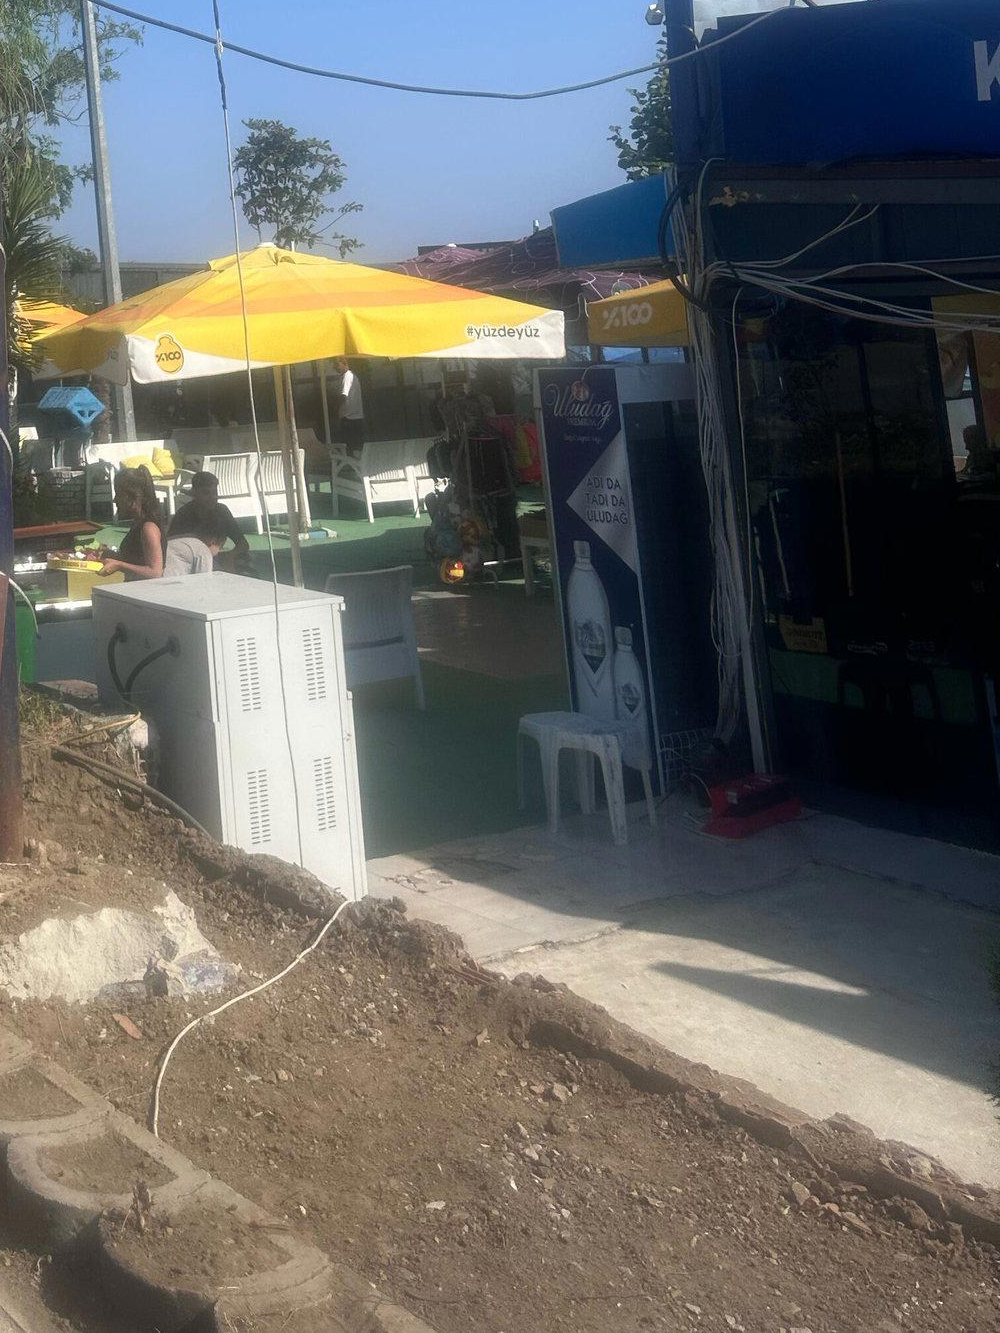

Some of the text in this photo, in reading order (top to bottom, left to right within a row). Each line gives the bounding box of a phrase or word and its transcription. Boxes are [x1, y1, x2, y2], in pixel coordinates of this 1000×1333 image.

[601, 302, 653, 330] %100
[466, 325, 540, 340] #yüzdeyüz
[543, 383, 614, 430] Uludağ
[606, 477, 621, 490] DA
[585, 492, 625, 507] TADI DA
[586, 509, 629, 525] ULUDAĞ
